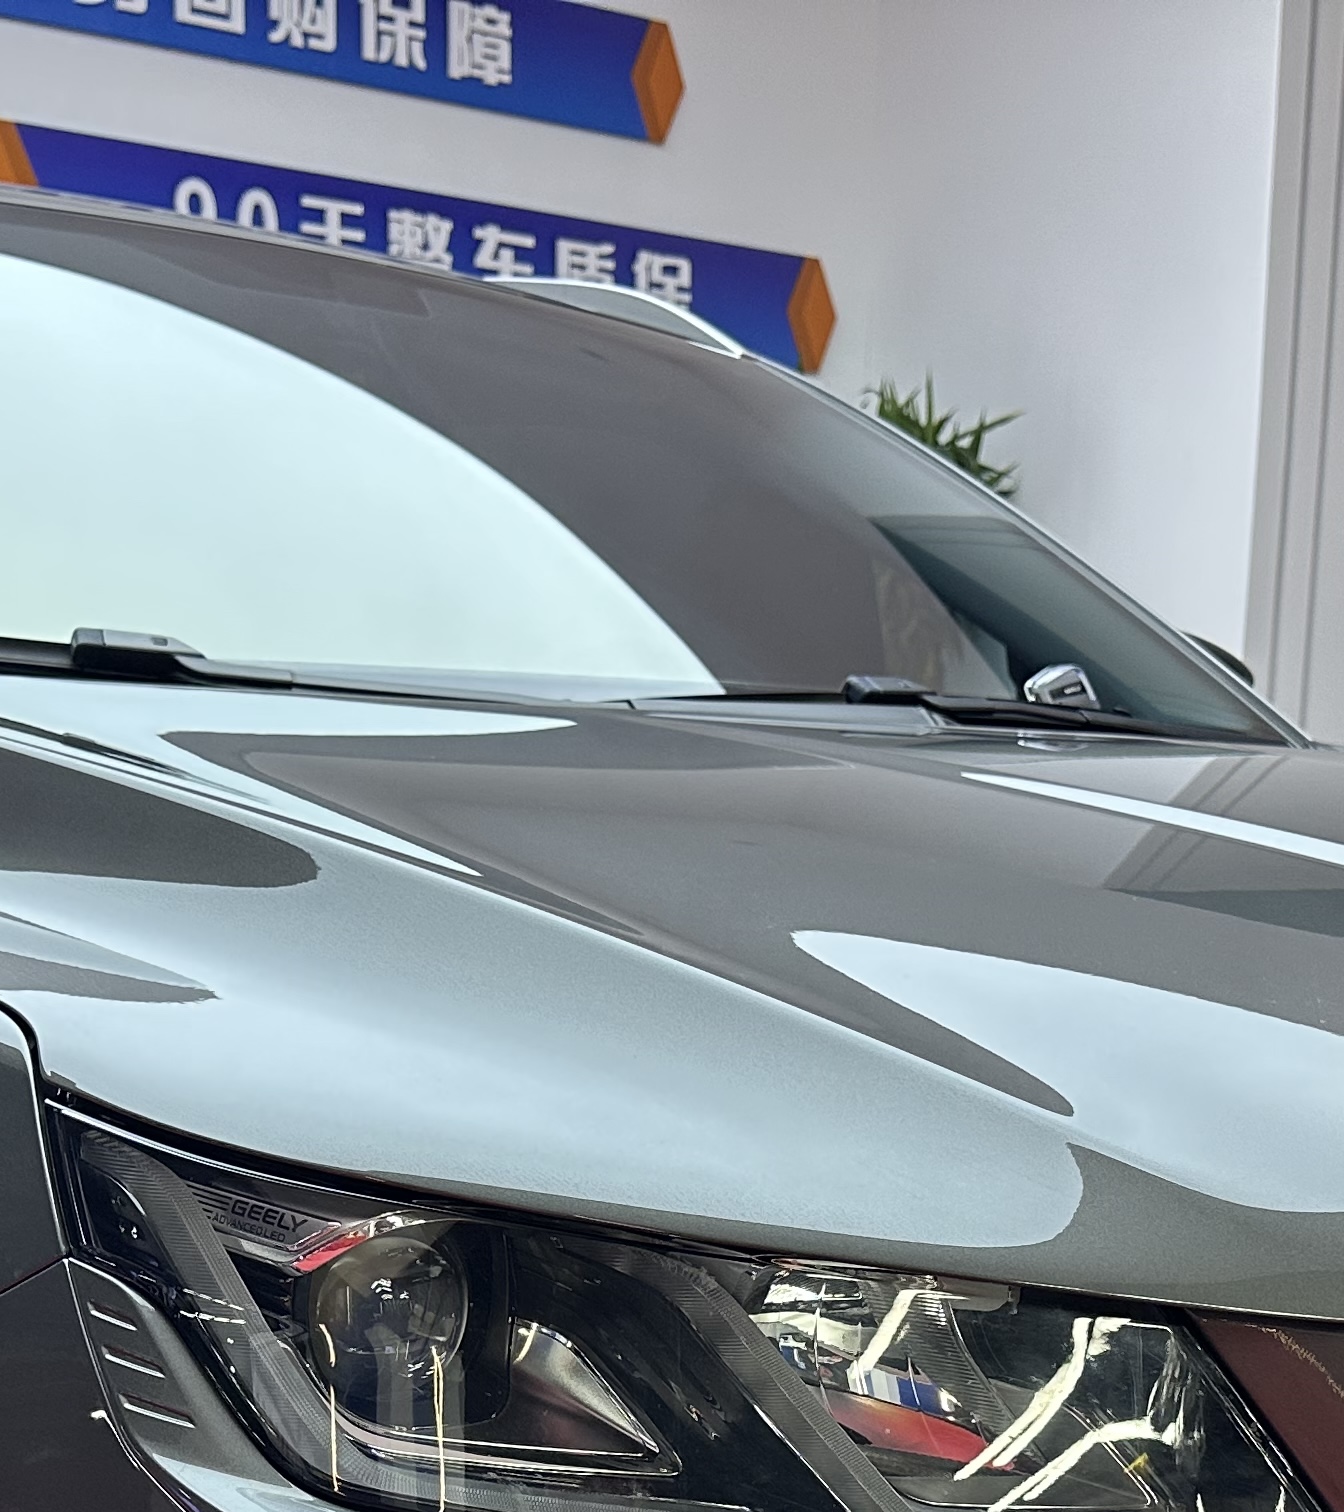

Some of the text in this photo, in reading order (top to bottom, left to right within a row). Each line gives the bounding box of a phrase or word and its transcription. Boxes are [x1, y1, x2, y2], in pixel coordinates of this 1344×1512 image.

[212, 1212, 286, 1243] ADVANCED LED
[231, 1199, 308, 1233] GEELY
